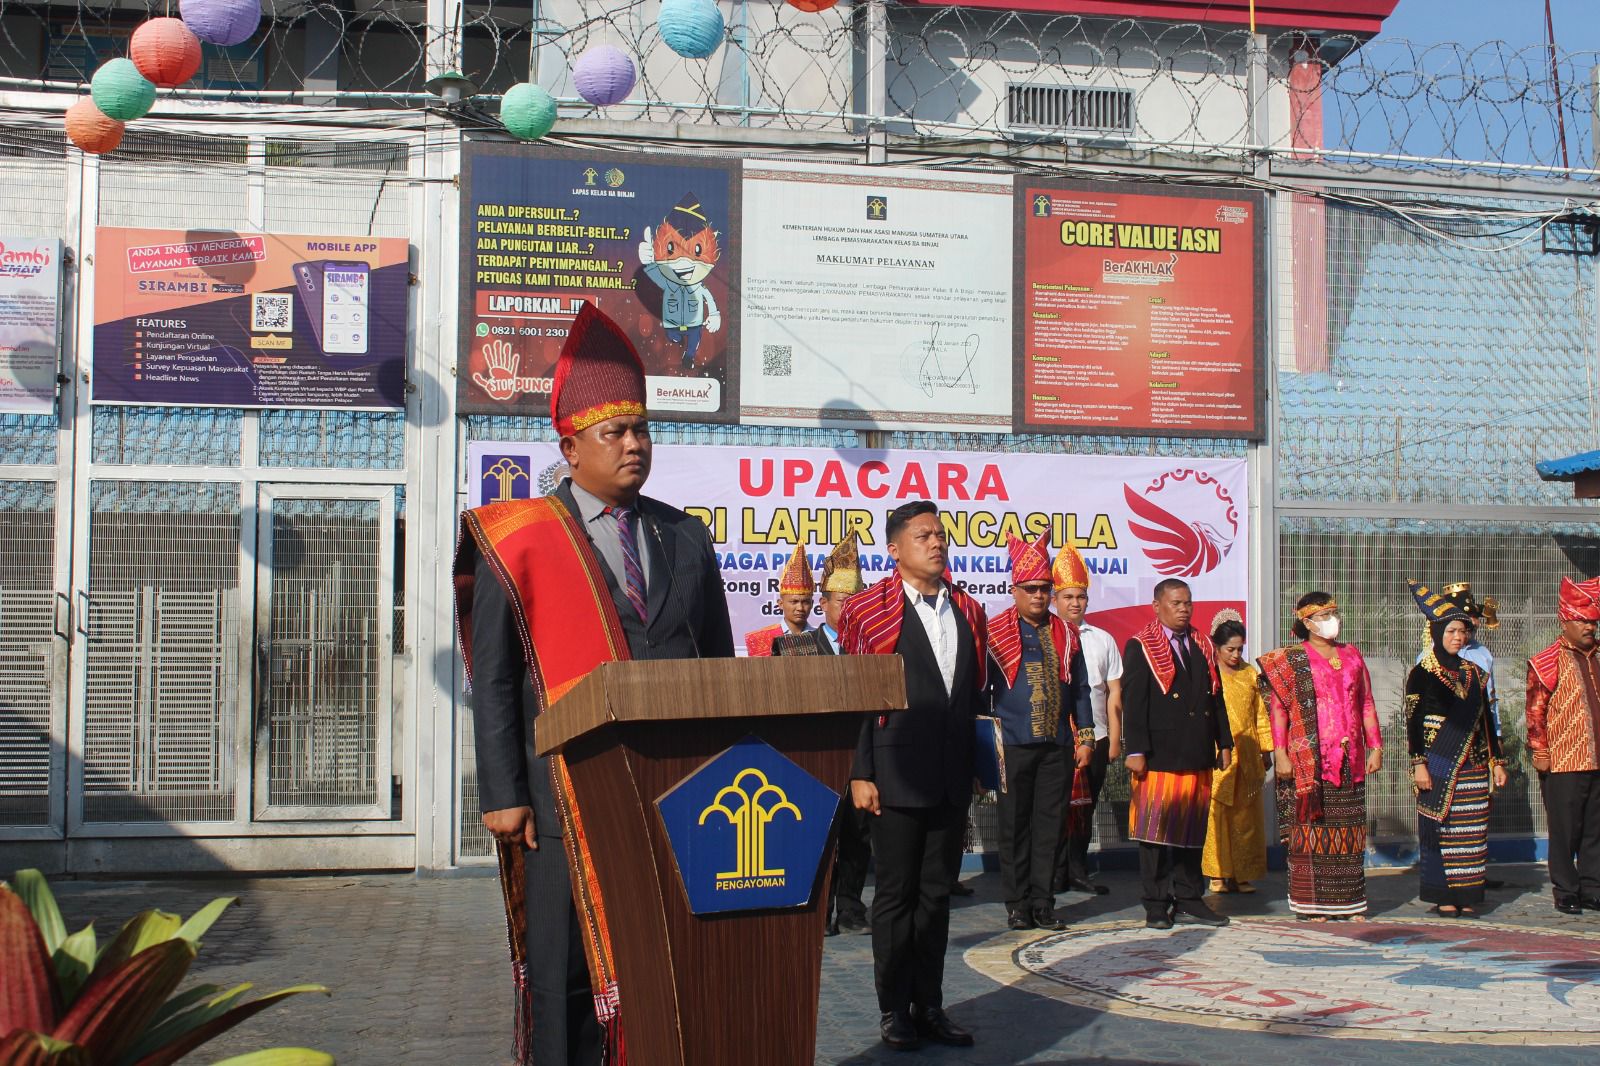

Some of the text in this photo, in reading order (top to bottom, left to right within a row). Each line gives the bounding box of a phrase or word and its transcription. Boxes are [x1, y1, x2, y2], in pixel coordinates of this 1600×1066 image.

[572, 188, 589, 196] LAPAS
[590, 189, 607, 197] KELAS
[477, 204, 580, 221] ANDA DIPERSULIT...?
[477, 221, 630, 240] PELAYANAN BERBELIT-BELIT...?
[782, 224, 823, 232] KEMENTERIAN
[919, 231, 949, 239] SUMATERA
[1061, 220, 1221, 253] CORE VALUE ASN
[307, 242, 377, 252] MOBILE APP
[476, 238, 595, 255] ADA PUNGUTAN LIAR...?
[812, 235, 840, 243] LEMBAGA
[840, 237, 894, 246] PEMASYARAKATAN
[131, 239, 256, 257] ANDA INGIN MENERIMA
[133, 250, 264, 270] LAYANAN TERBAIK KAMI?
[476, 255, 624, 273] TERDAPAT PENYIMPANGAN...?
[816, 254, 935, 269] MAKLUMAT PELAYANAN
[0, 263, 41, 275] EMAN
[1104, 261, 1173, 275] BerAKHLAK
[139, 280, 208, 293] SIRAMBI
[476, 271, 638, 290] PETUGAS KAMI TIDAK RAMAH...?
[136, 319, 187, 329] FEATURES
[146, 331, 215, 340] Pendaftaran Online
[491, 326, 569, 337] 0821 6001 2301
[146, 342, 211, 351] Kunjungan Virtual
[146, 352, 218, 363] Layanan Pengaduan
[146, 363, 249, 374] Survey Kepuasan Masyarakat
[146, 374, 178, 382] Headline
[489, 377, 554, 393] STOP PUNG
[656, 388, 709, 399] BerAKHLAK
[739, 458, 1010, 501] UPACARA
[742, 507, 875, 545] LAHIR
[886, 508, 1118, 550] NCASILA
[716, 553, 768, 571] BAGA
[971, 555, 1013, 574] KELA
[1088, 557, 1128, 575] NJAI
[722, 579, 761, 597] tong
[761, 602, 783, 616] da
[716, 877, 786, 891] PENGAYOMAN
